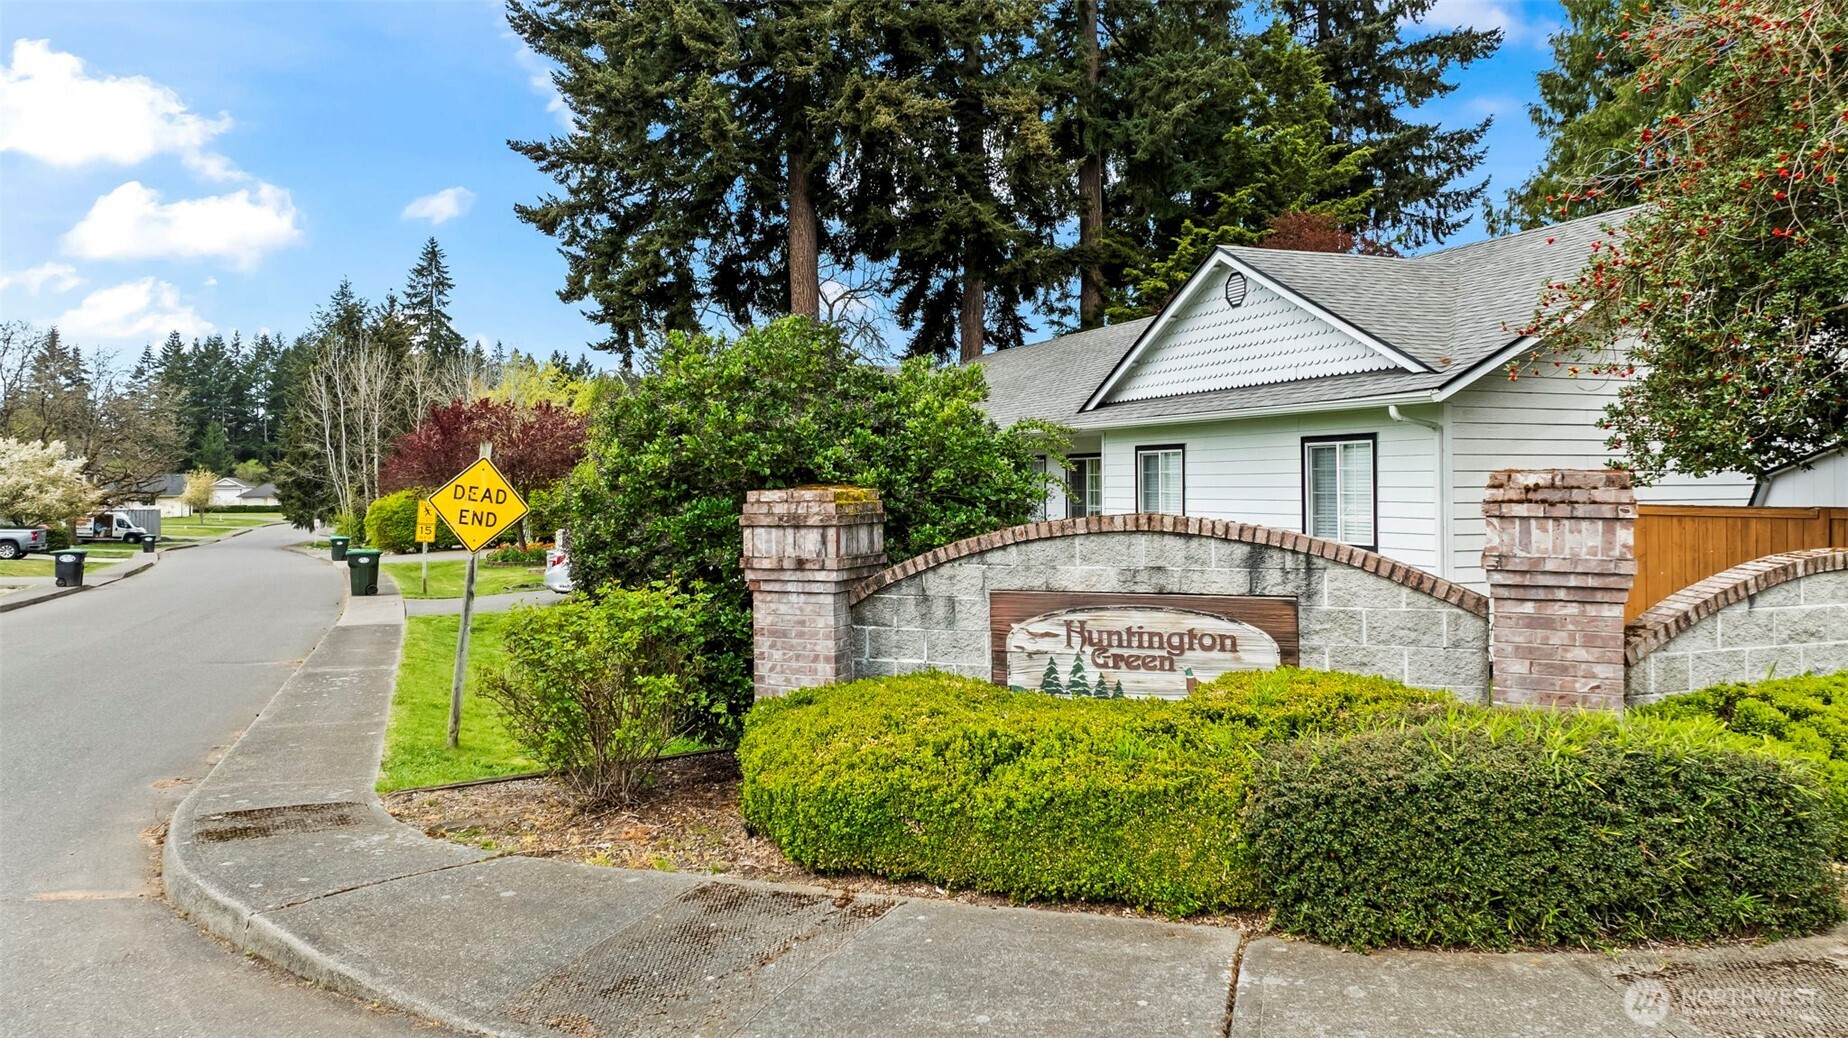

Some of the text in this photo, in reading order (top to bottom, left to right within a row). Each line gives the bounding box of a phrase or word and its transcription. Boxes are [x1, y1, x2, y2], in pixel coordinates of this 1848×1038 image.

[453, 484, 507, 504] DEAD
[458, 509, 497, 527] END
[420, 526, 432, 535] 15
[1065, 620, 1238, 656] Huntington
[1091, 648, 1176, 671] Green
